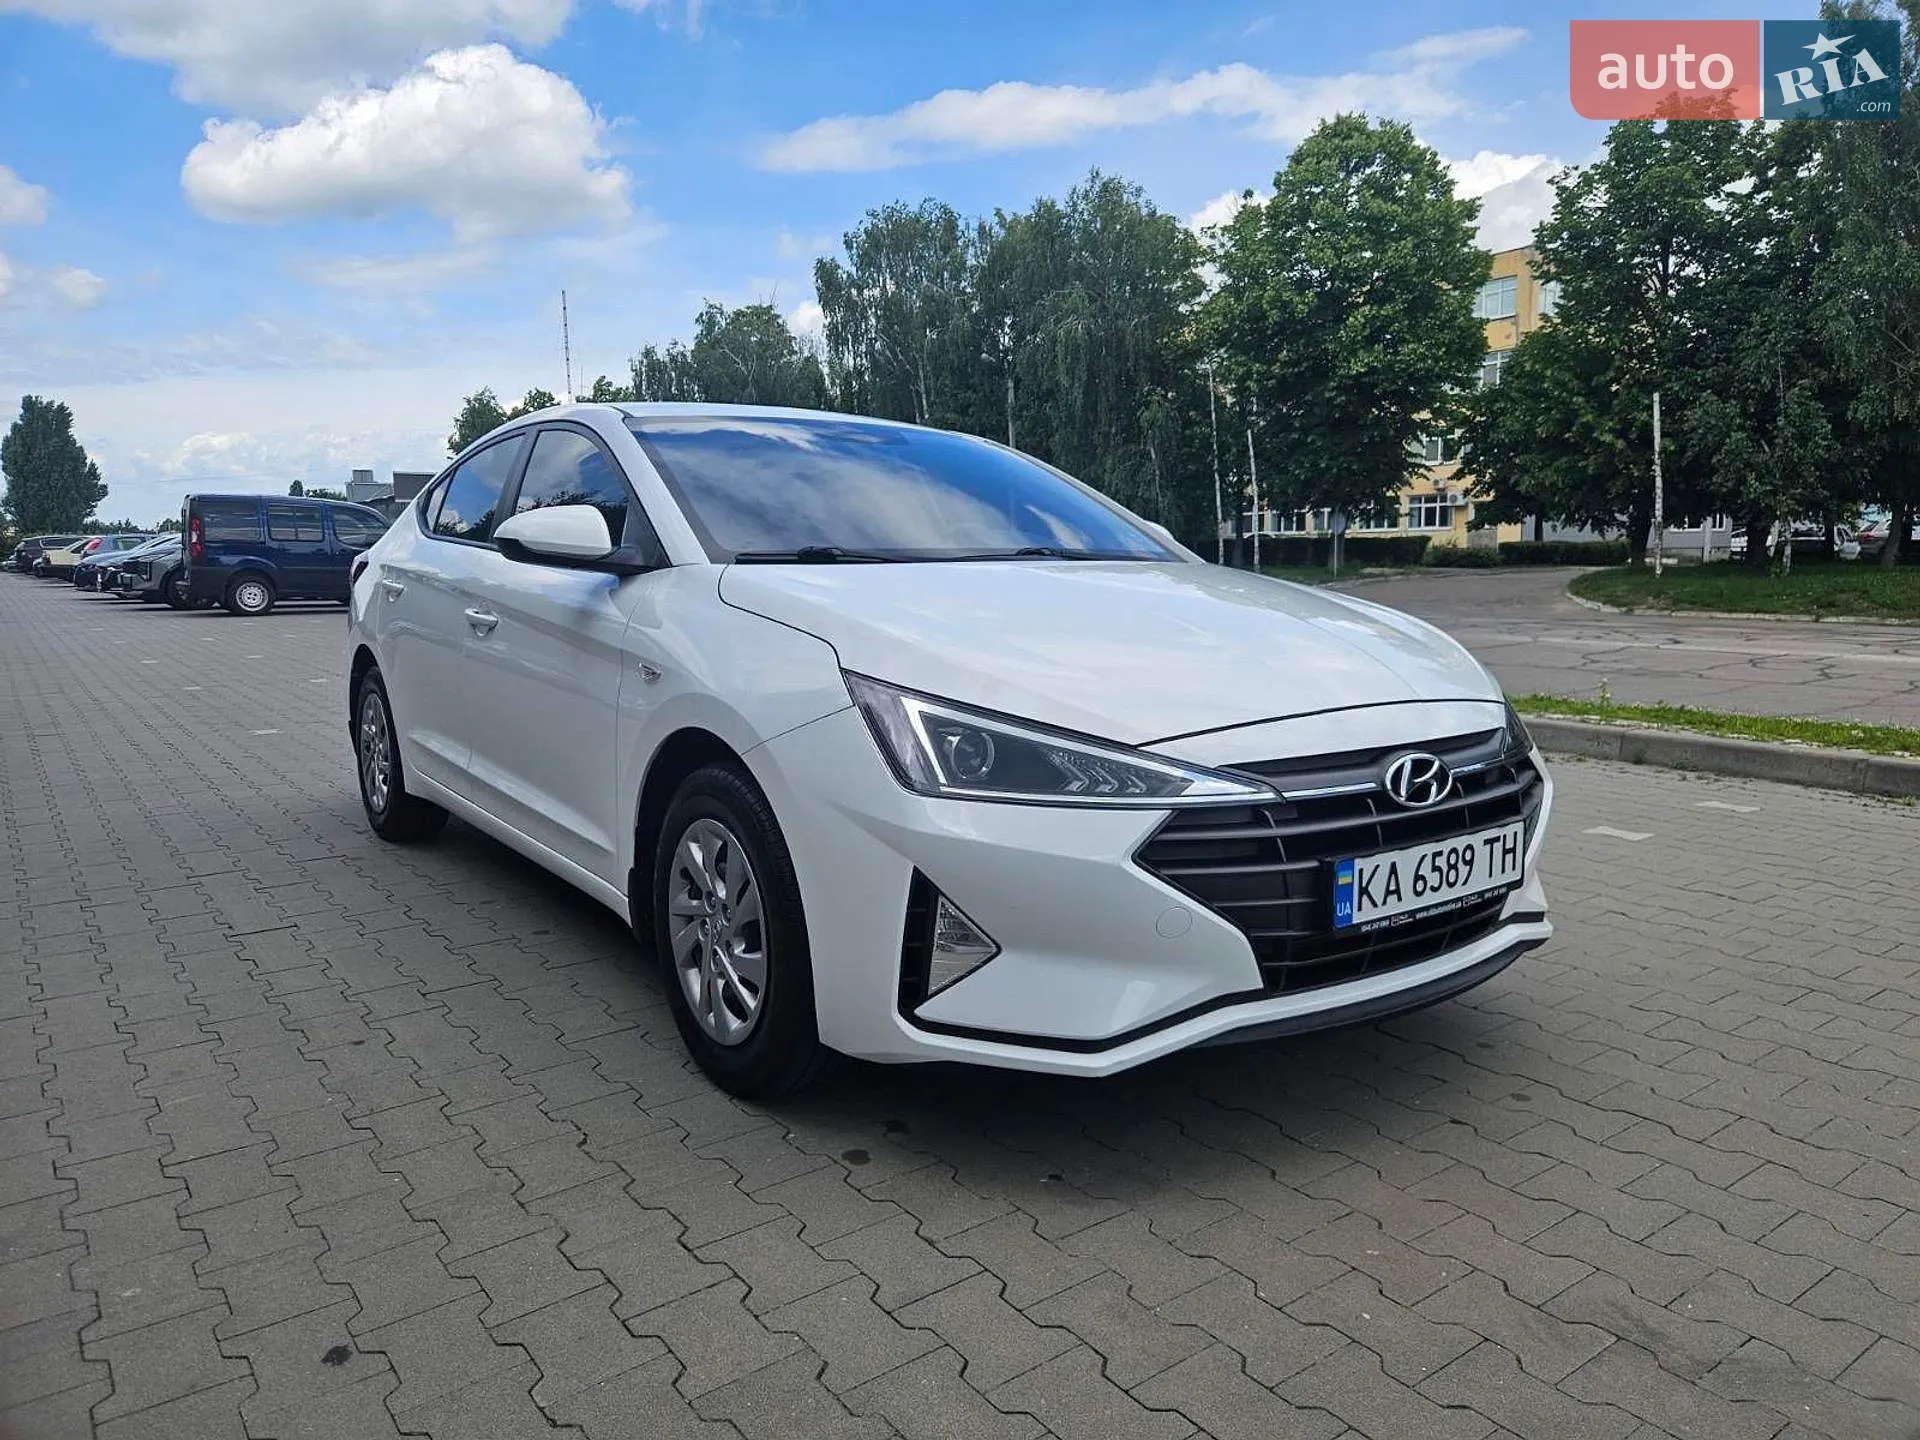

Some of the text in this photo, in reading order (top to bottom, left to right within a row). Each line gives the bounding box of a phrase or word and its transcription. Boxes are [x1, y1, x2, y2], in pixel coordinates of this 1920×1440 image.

[1357, 861, 1402, 912] KA
[1412, 843, 1475, 897] 6589
[1483, 831, 1518, 878] TH
[1336, 901, 1352, 917] UA
